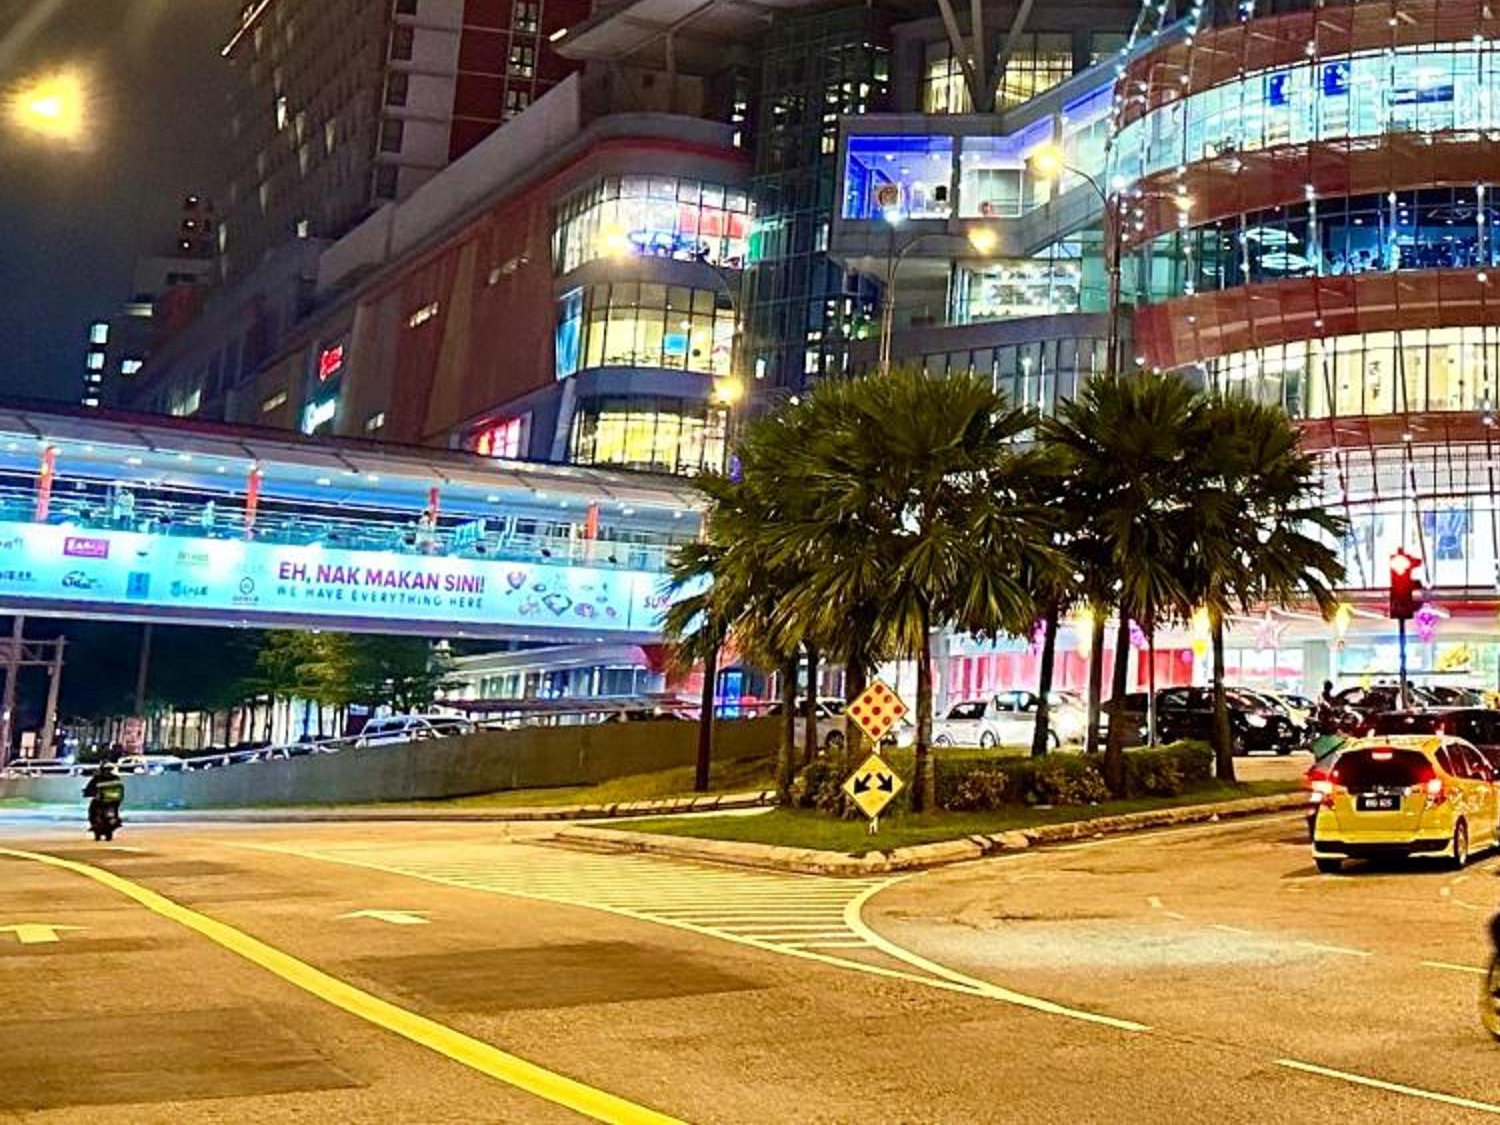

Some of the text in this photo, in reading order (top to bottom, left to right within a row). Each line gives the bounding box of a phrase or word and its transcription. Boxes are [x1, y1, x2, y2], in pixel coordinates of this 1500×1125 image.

[278, 561, 486, 594] EH, NAK MAKAN SINI!
[277, 585, 484, 609] WE HAVE EVERYTHING HERE
